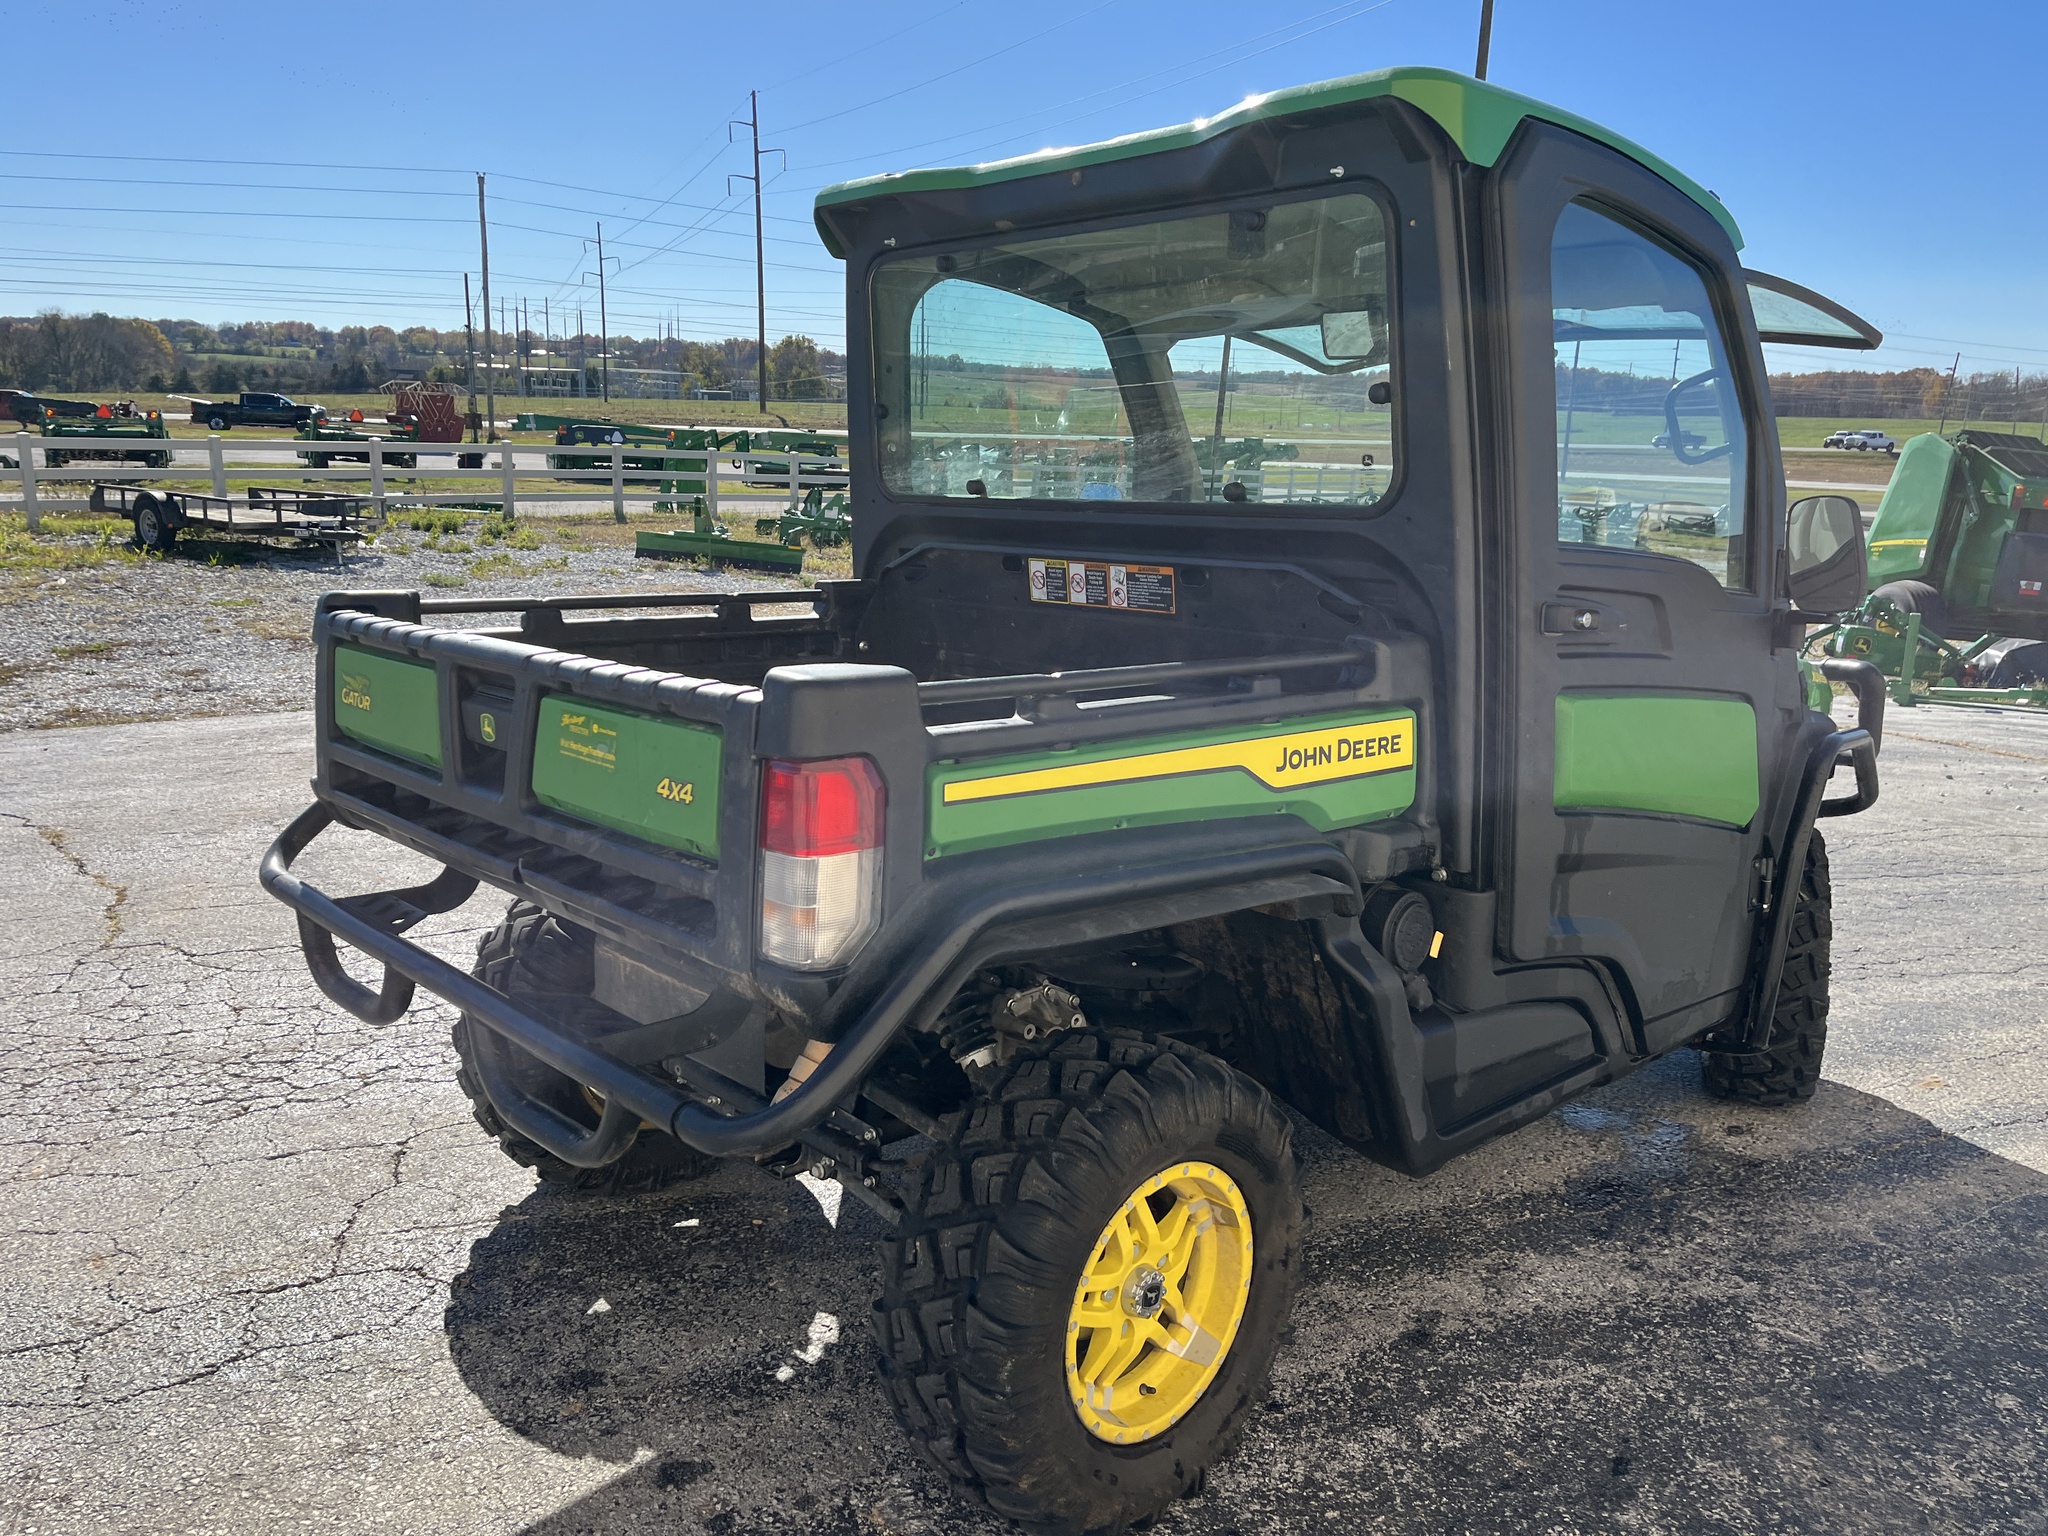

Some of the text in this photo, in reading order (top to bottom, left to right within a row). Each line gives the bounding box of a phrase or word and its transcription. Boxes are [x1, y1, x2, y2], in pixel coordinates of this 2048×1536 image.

[341, 687, 371, 711] GATOR
[1276, 734, 1402, 772] JOHN DEERE
